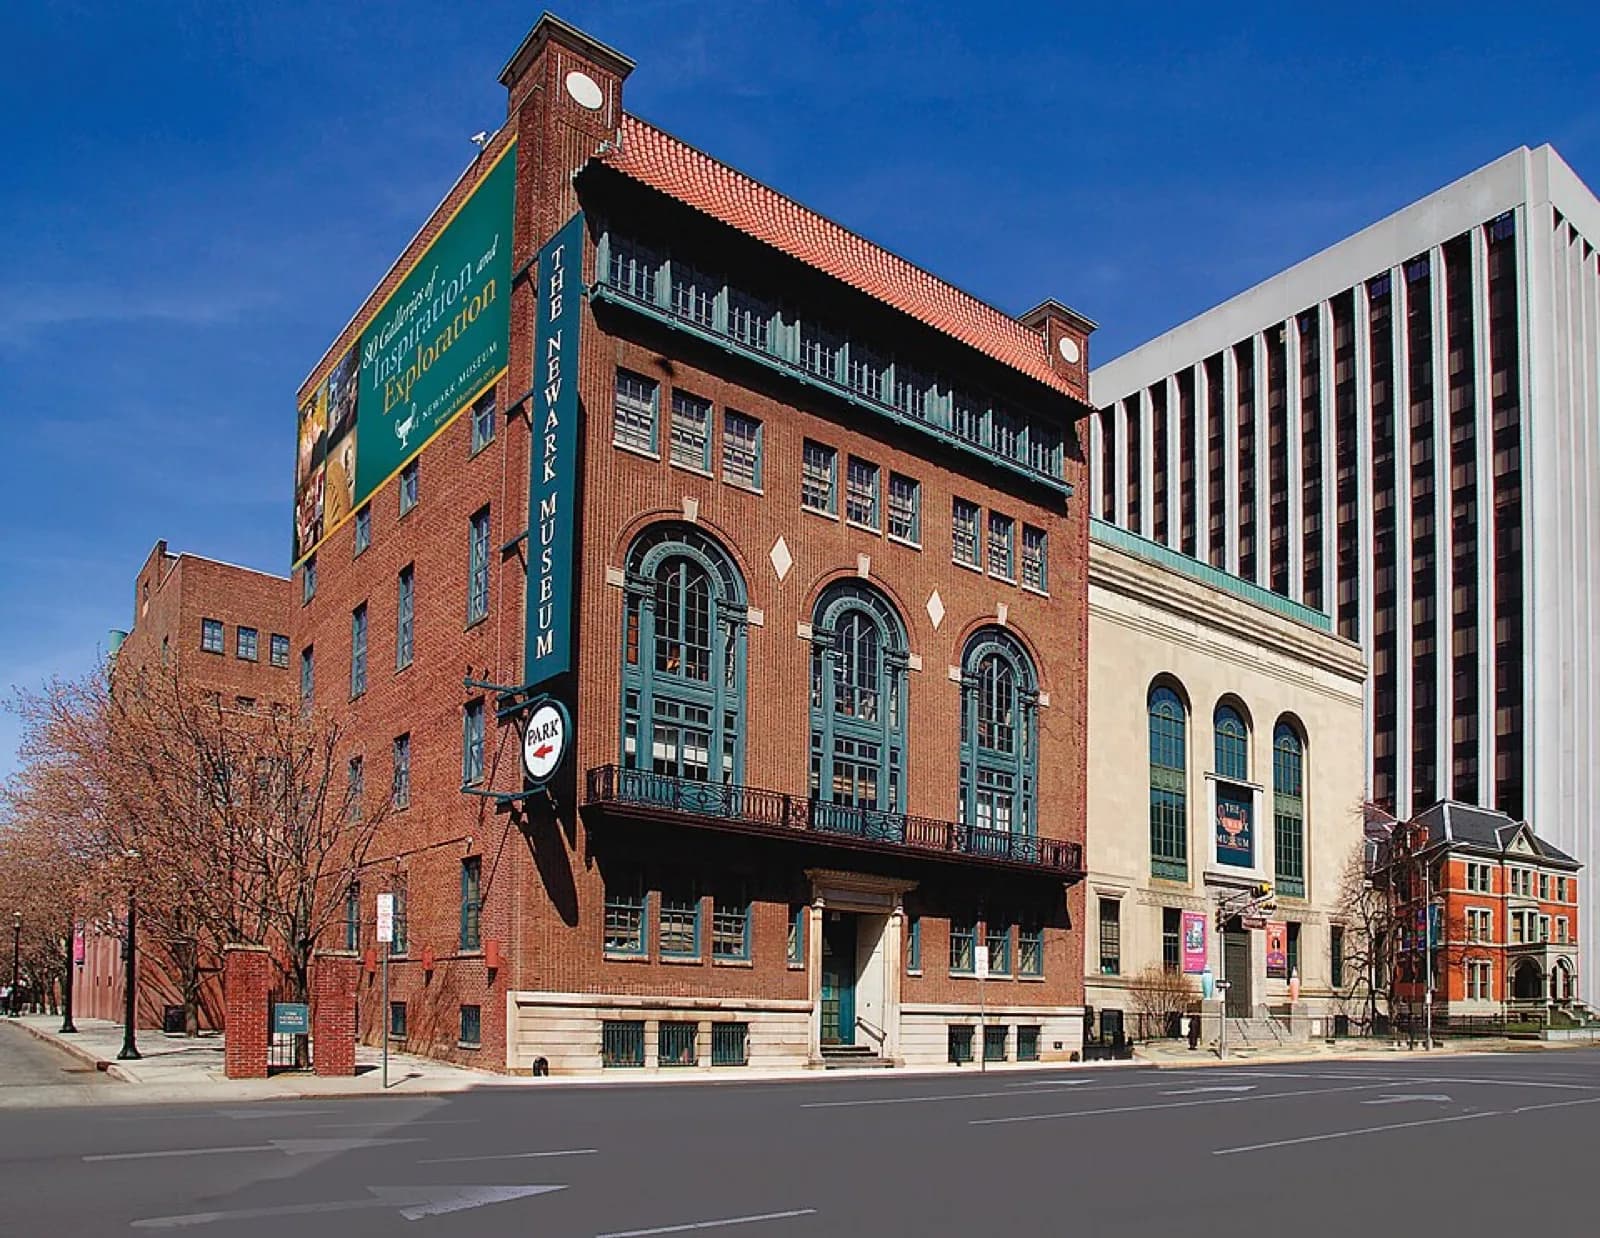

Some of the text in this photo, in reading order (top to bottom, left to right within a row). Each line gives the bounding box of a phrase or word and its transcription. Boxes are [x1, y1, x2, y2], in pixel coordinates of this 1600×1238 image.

[363, 264, 439, 369] 80 Galleries of
[373, 233, 499, 391] Inspiration and
[383, 278, 497, 416] Exploration
[457, 340, 497, 388] MUSEUM
[535, 244, 565, 660] THE NEWARK MUSEUM
[527, 717, 559, 747] PARK
